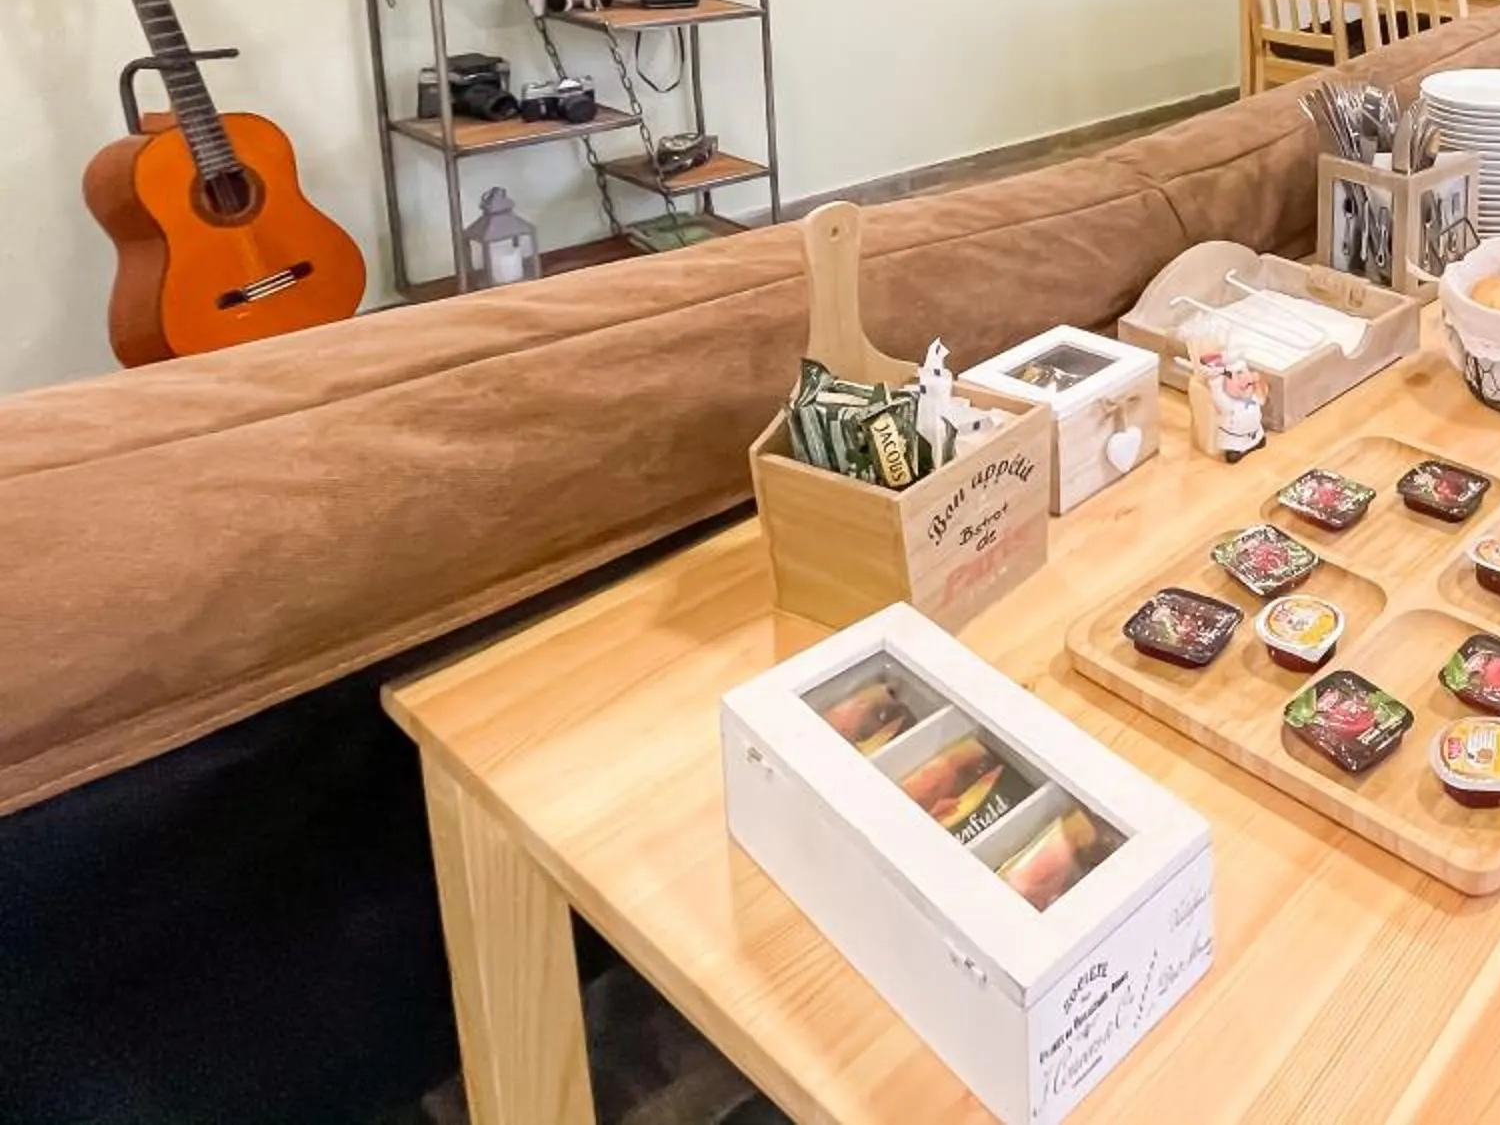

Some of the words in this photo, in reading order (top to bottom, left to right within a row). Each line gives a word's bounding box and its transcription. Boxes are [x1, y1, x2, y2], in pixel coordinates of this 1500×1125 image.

[873, 423, 907, 482] JACOBS
[928, 488, 965, 546] Bon
[975, 530, 997, 551] de
